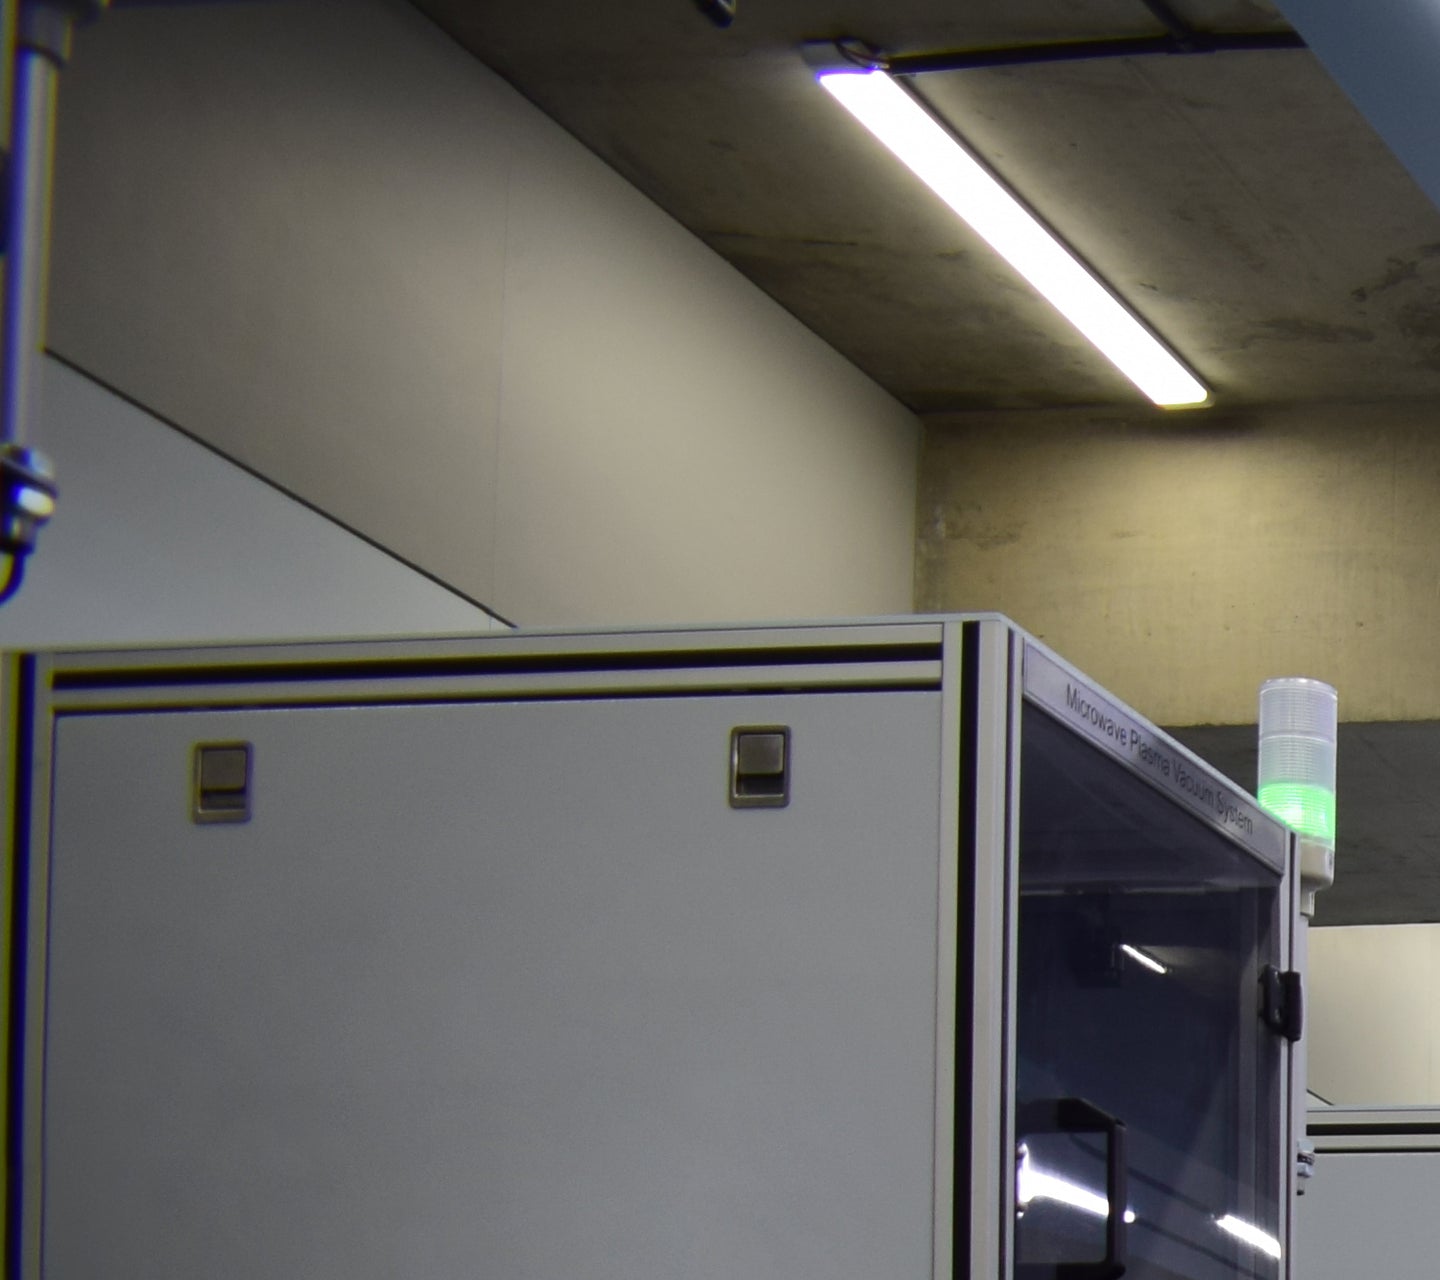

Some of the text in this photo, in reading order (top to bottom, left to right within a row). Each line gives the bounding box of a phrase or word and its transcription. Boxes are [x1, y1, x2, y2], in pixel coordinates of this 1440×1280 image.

[1066, 683, 1254, 836] Microwave Plasma Vacuum System
